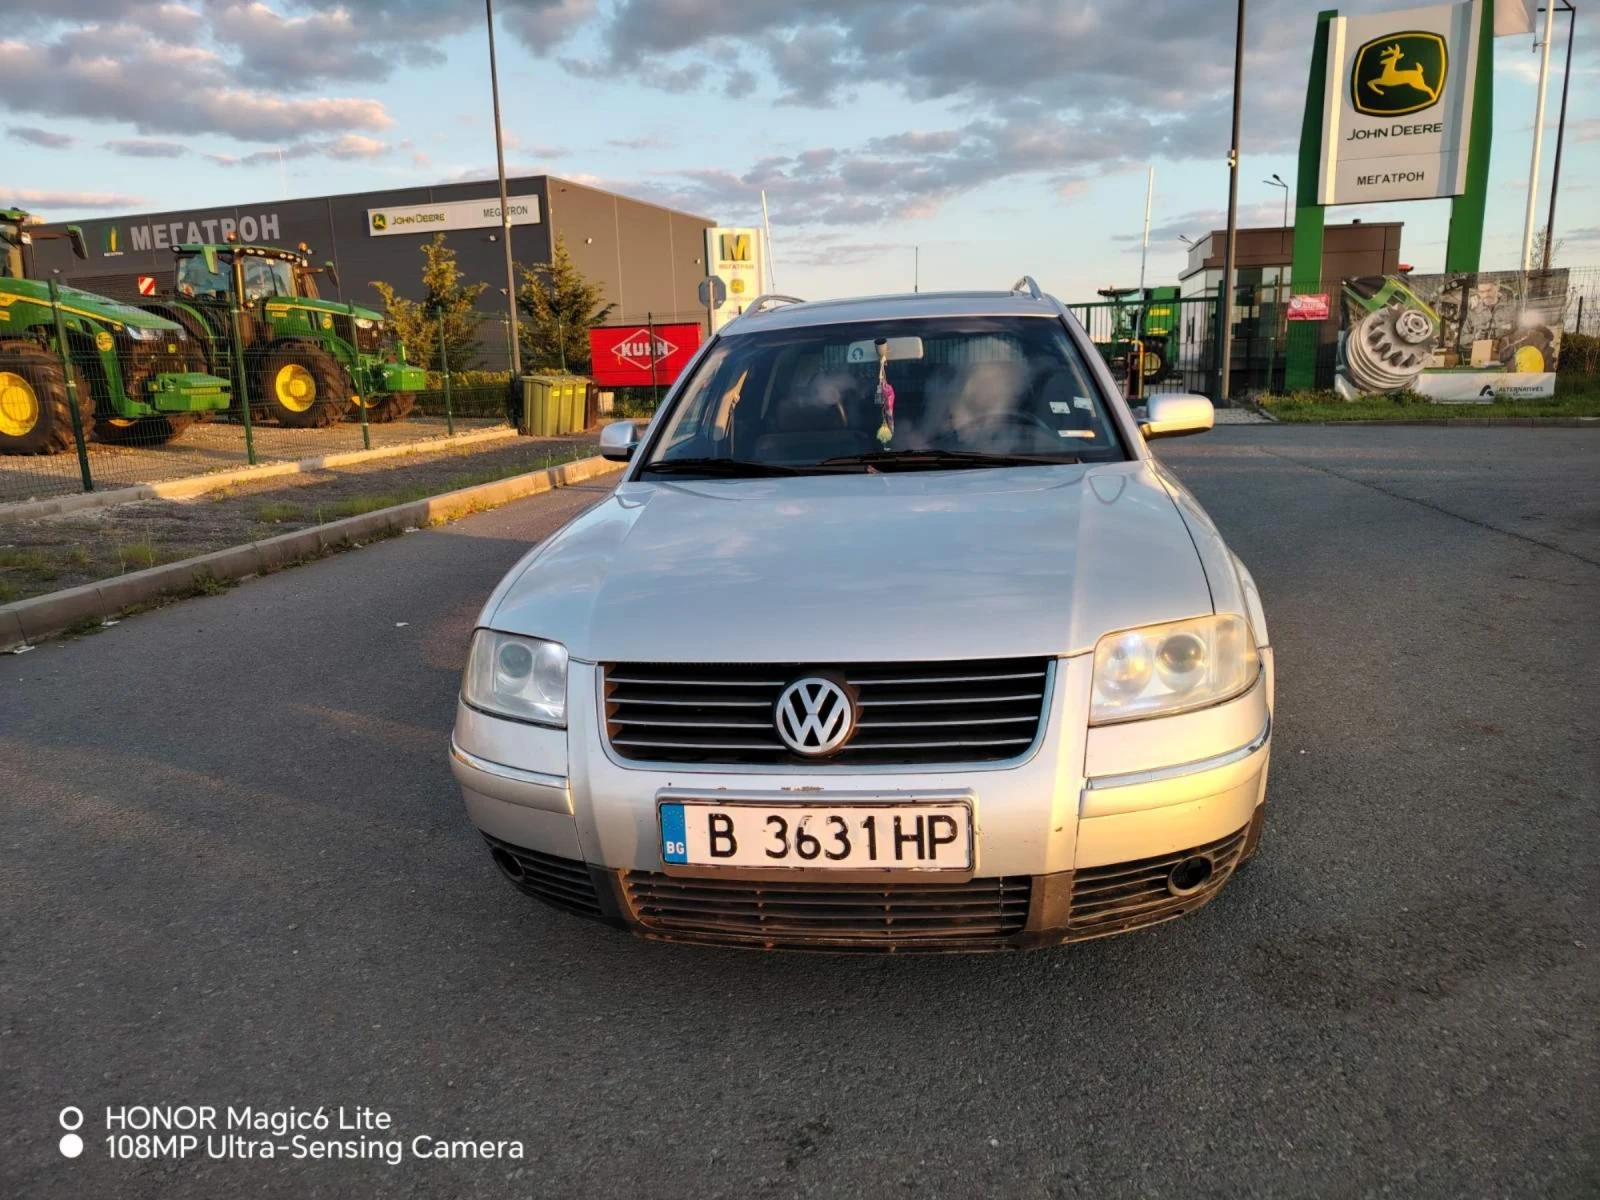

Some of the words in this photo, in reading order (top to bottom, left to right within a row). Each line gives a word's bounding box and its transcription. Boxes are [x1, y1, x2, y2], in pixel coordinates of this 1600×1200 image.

[1346, 127, 1389, 141] JOHN
[1391, 122, 1444, 137] DEERE
[1356, 171, 1425, 186] МЕГАТРОН
[483, 205, 528, 218] MEGTRON
[391, 215, 415, 225] JOHN
[416, 213, 445, 223] DEERE
[130, 214, 280, 251] МЕГАТРОН
[621, 342, 669, 356] KUHN
[765, 814, 877, 861] 3631
[665, 841, 685, 855] BG
